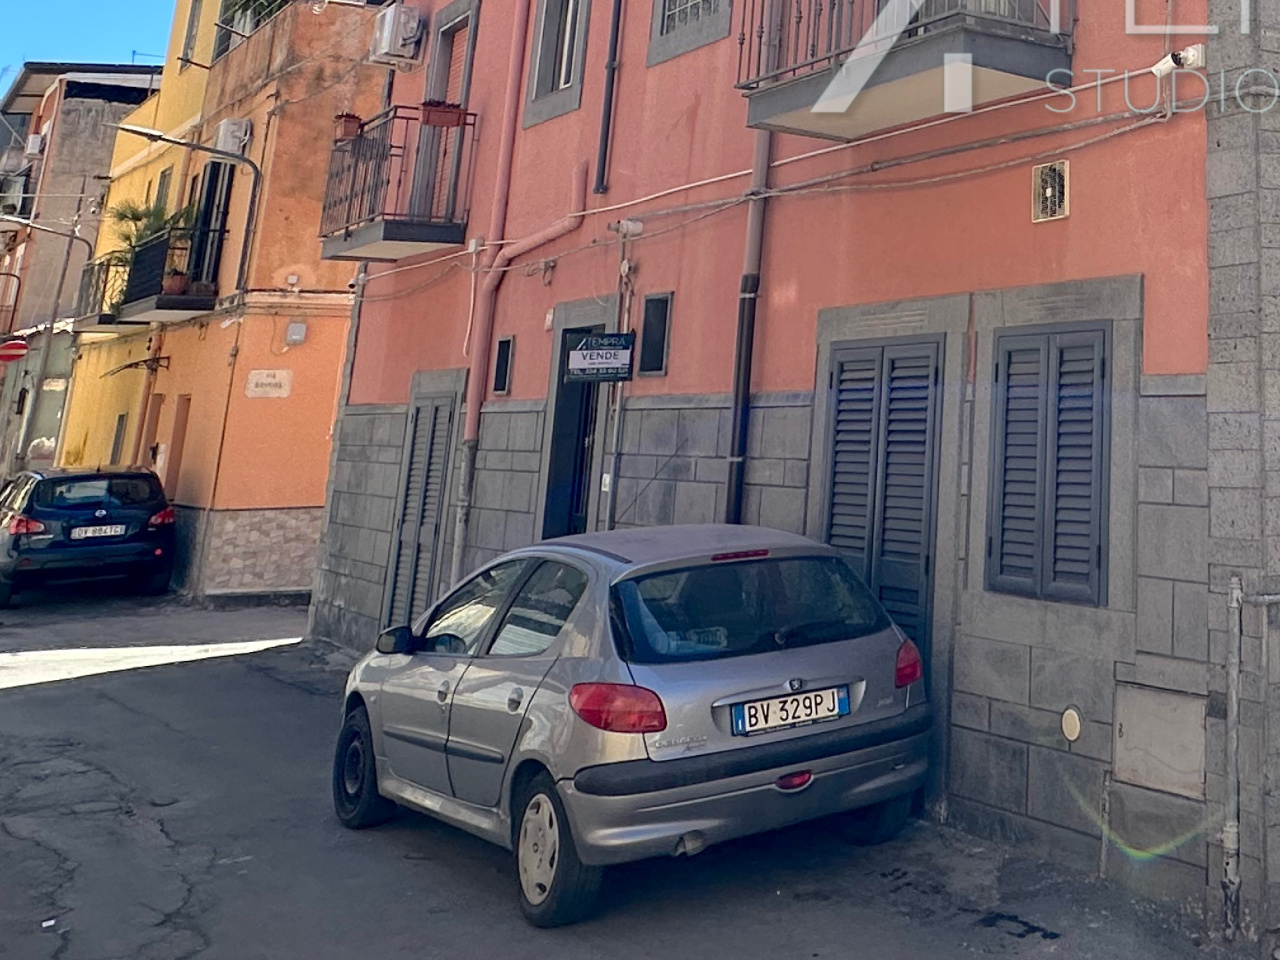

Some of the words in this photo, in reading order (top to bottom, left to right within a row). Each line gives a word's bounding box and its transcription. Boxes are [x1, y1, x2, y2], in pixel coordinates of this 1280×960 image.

[587, 337, 626, 347] TEMPRA
[581, 351, 619, 360] VENDE
[747, 702, 770, 727] BV
[778, 691, 836, 721] 329PJ
